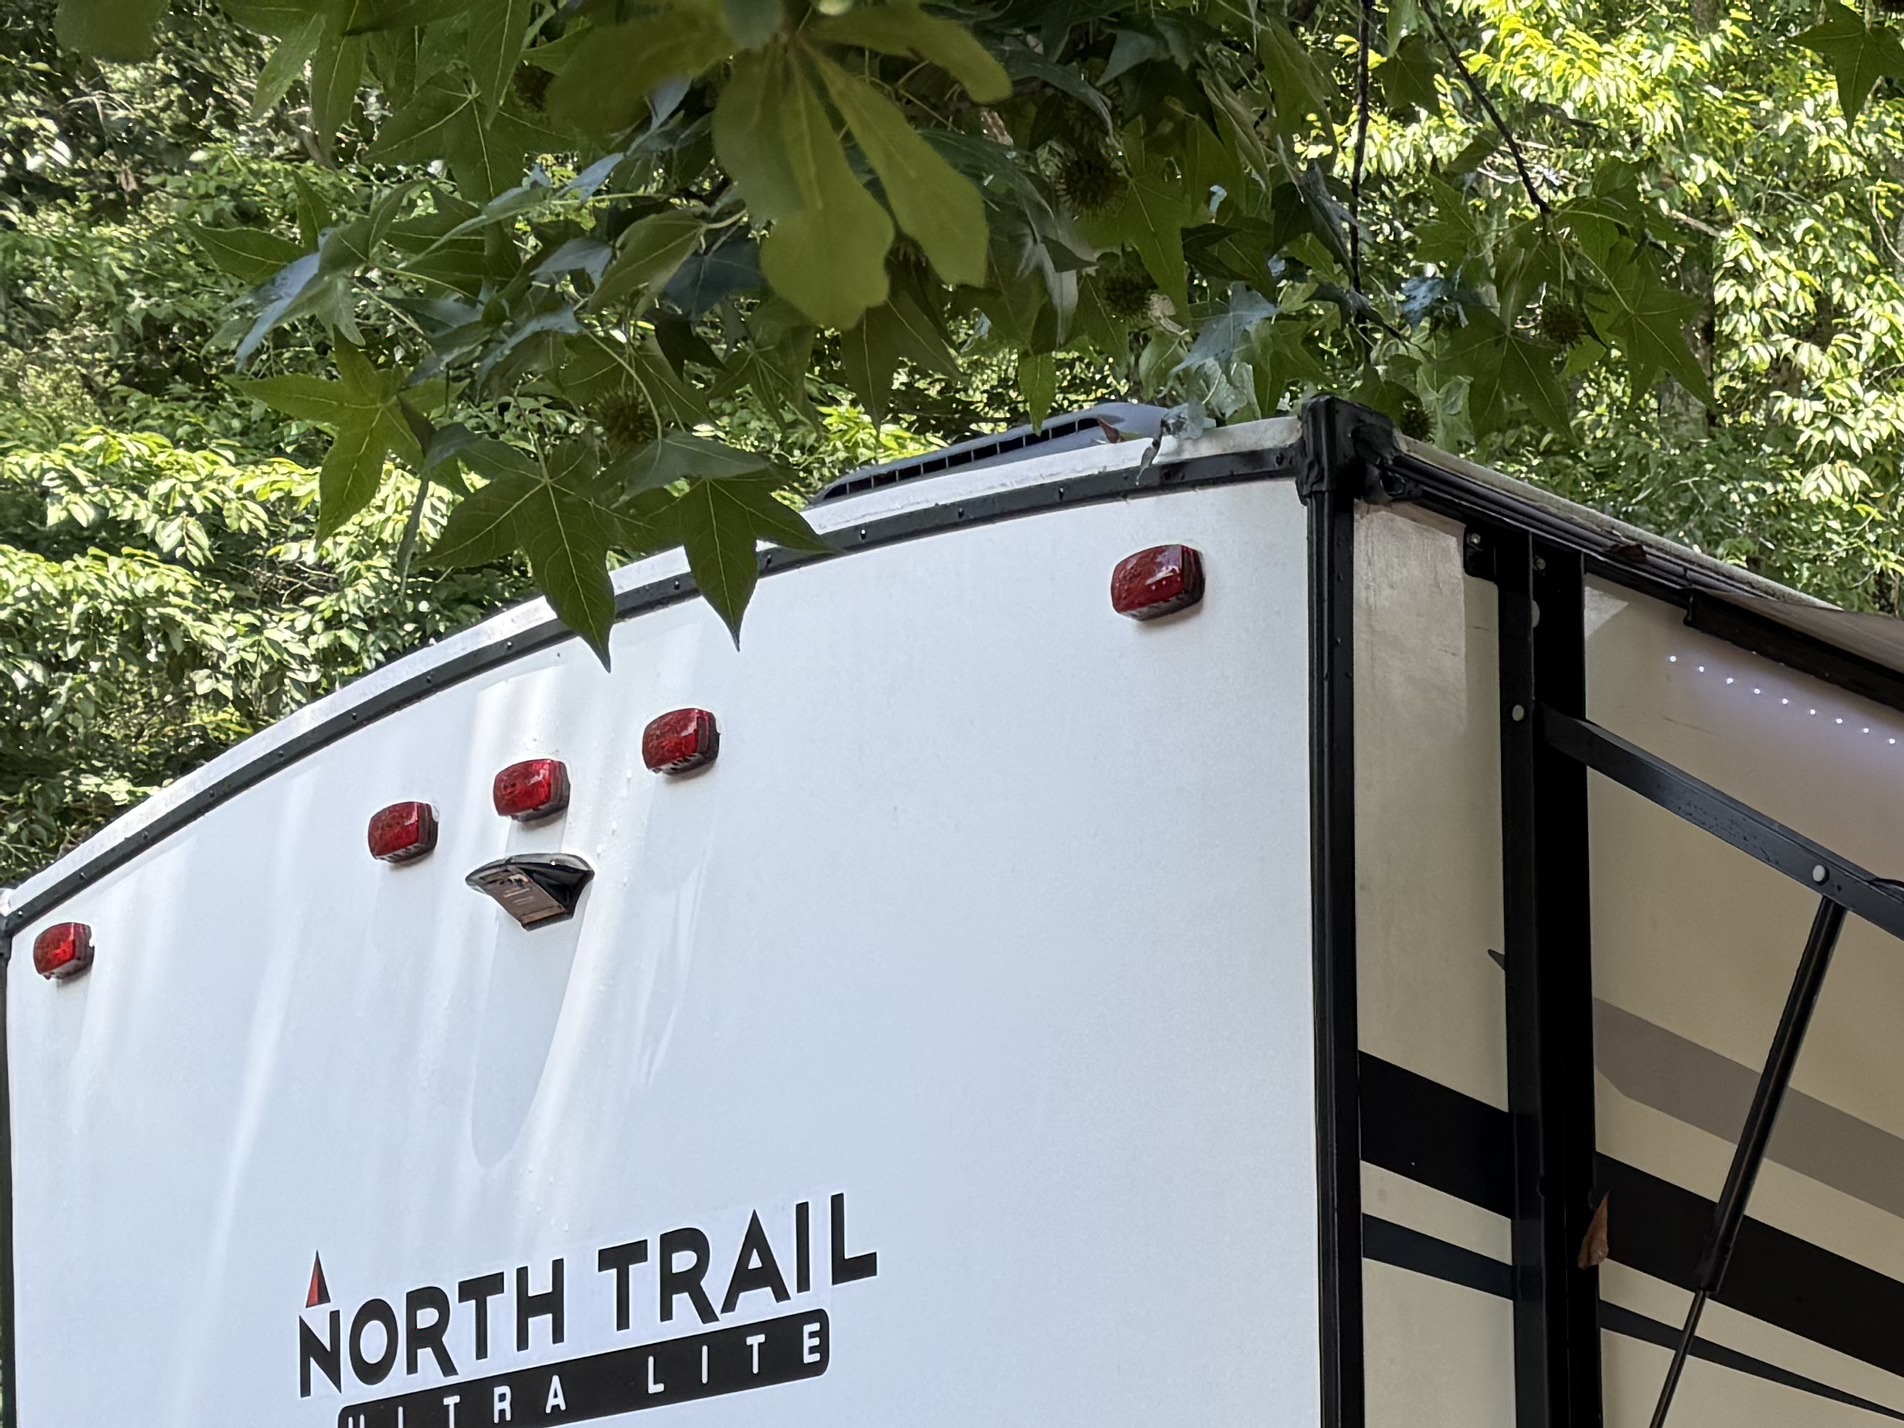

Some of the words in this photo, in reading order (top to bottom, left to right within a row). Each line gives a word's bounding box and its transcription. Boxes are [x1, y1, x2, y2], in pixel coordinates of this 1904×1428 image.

[299, 1257, 565, 1398] NORTH
[599, 1193, 877, 1330] TRAIL
[647, 1321, 822, 1394] LITE
